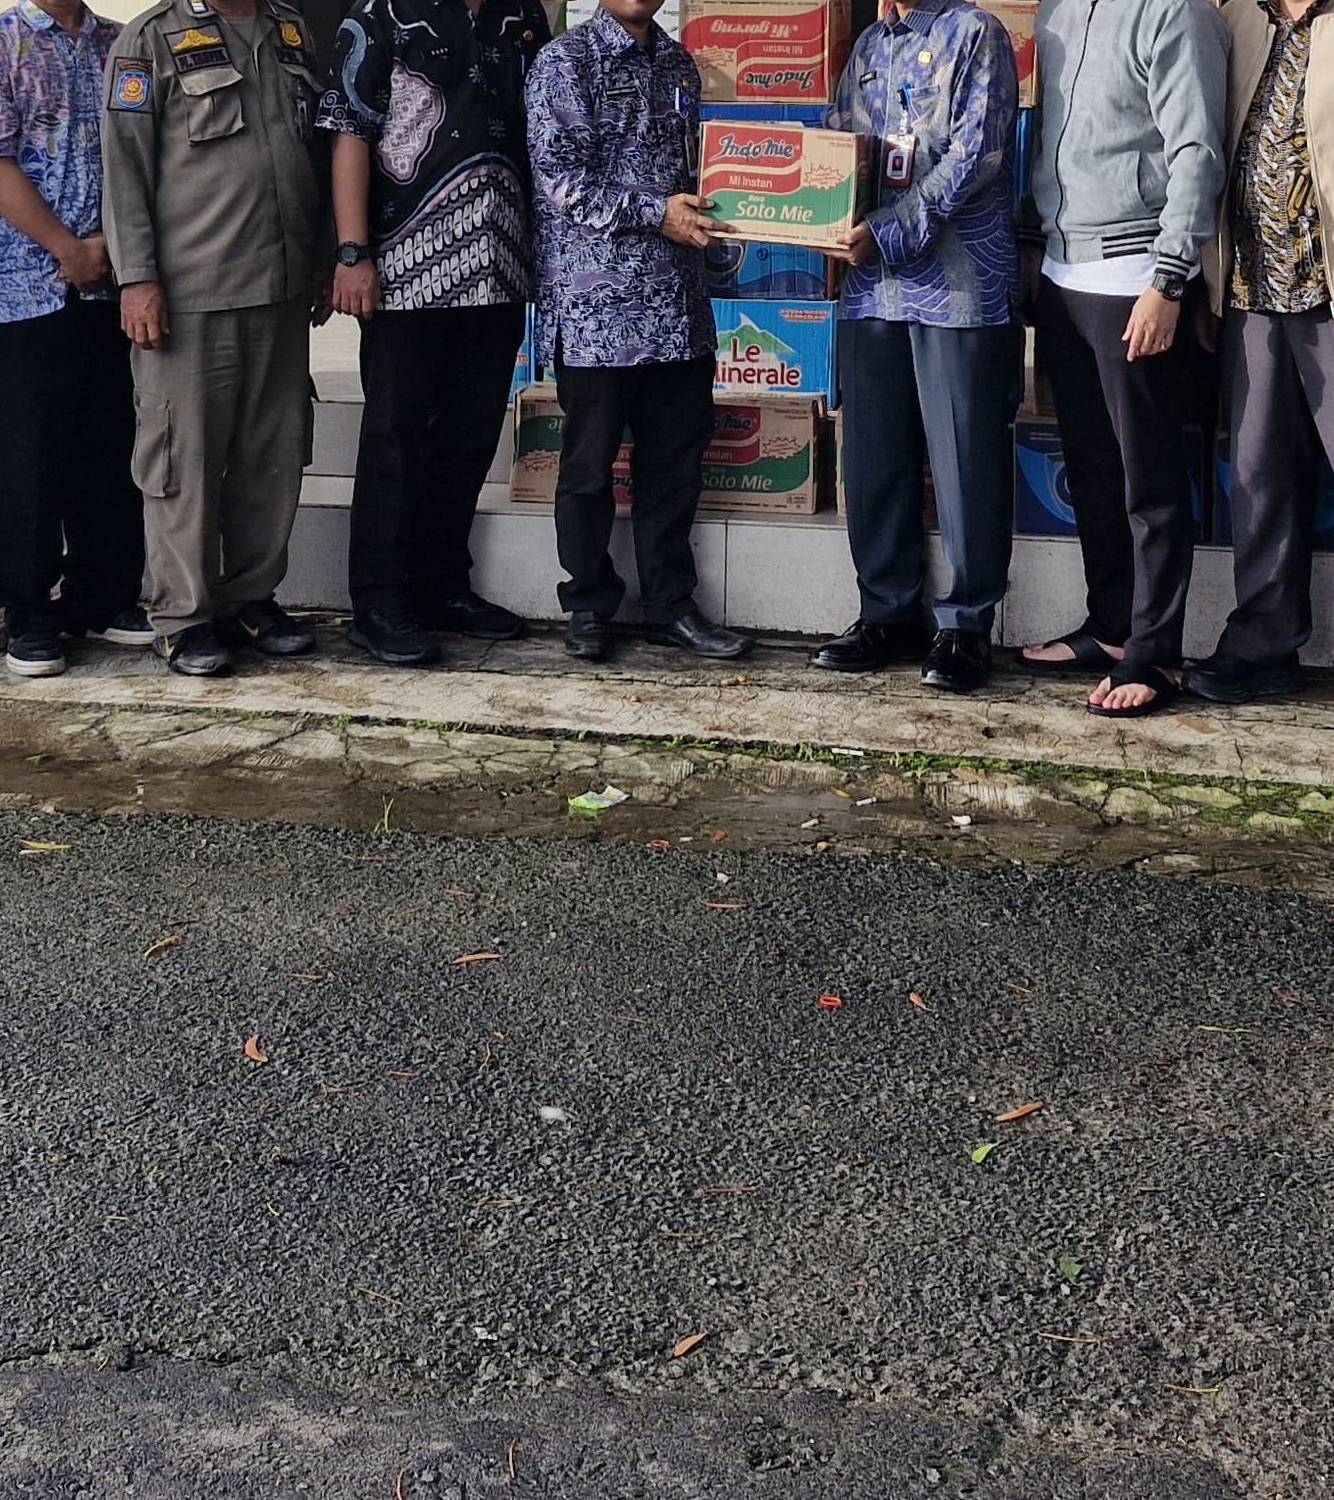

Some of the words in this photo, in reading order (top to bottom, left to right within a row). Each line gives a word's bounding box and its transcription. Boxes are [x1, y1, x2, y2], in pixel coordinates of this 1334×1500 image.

[710, 19, 770, 35] goreng
[711, 132, 796, 161] Indomie
[742, 175, 773, 189] Instan
[735, 199, 776, 220] Soto
[780, 205, 814, 223] Mie
[731, 337, 761, 363] Le
[741, 474, 773, 491] Mie
